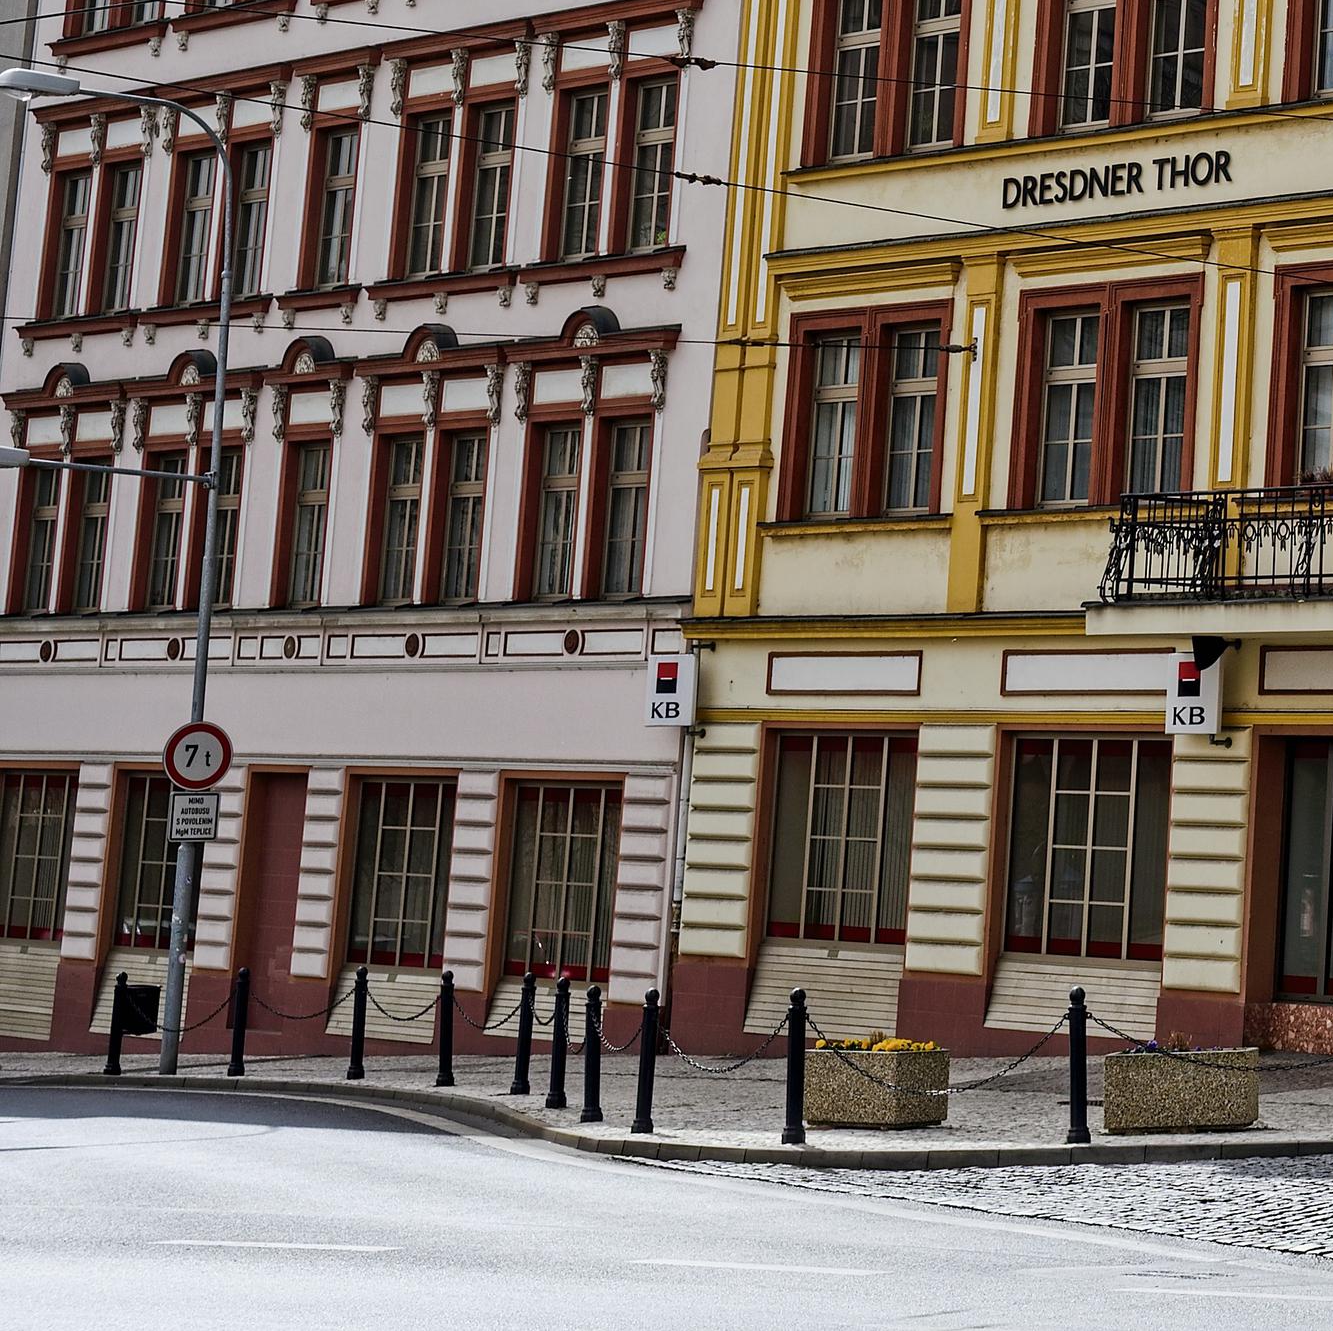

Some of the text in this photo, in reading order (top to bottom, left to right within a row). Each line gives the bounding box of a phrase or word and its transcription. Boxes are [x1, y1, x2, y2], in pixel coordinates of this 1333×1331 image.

[1002, 150, 1232, 209] DRESDNER THOR
[651, 702, 680, 718] KB
[1172, 706, 1205, 725] KB
[185, 744, 211, 768] 7 t
[188, 797, 204, 805] MIMO
[176, 817, 181, 825] S
[190, 827, 212, 836] TEPLICE
